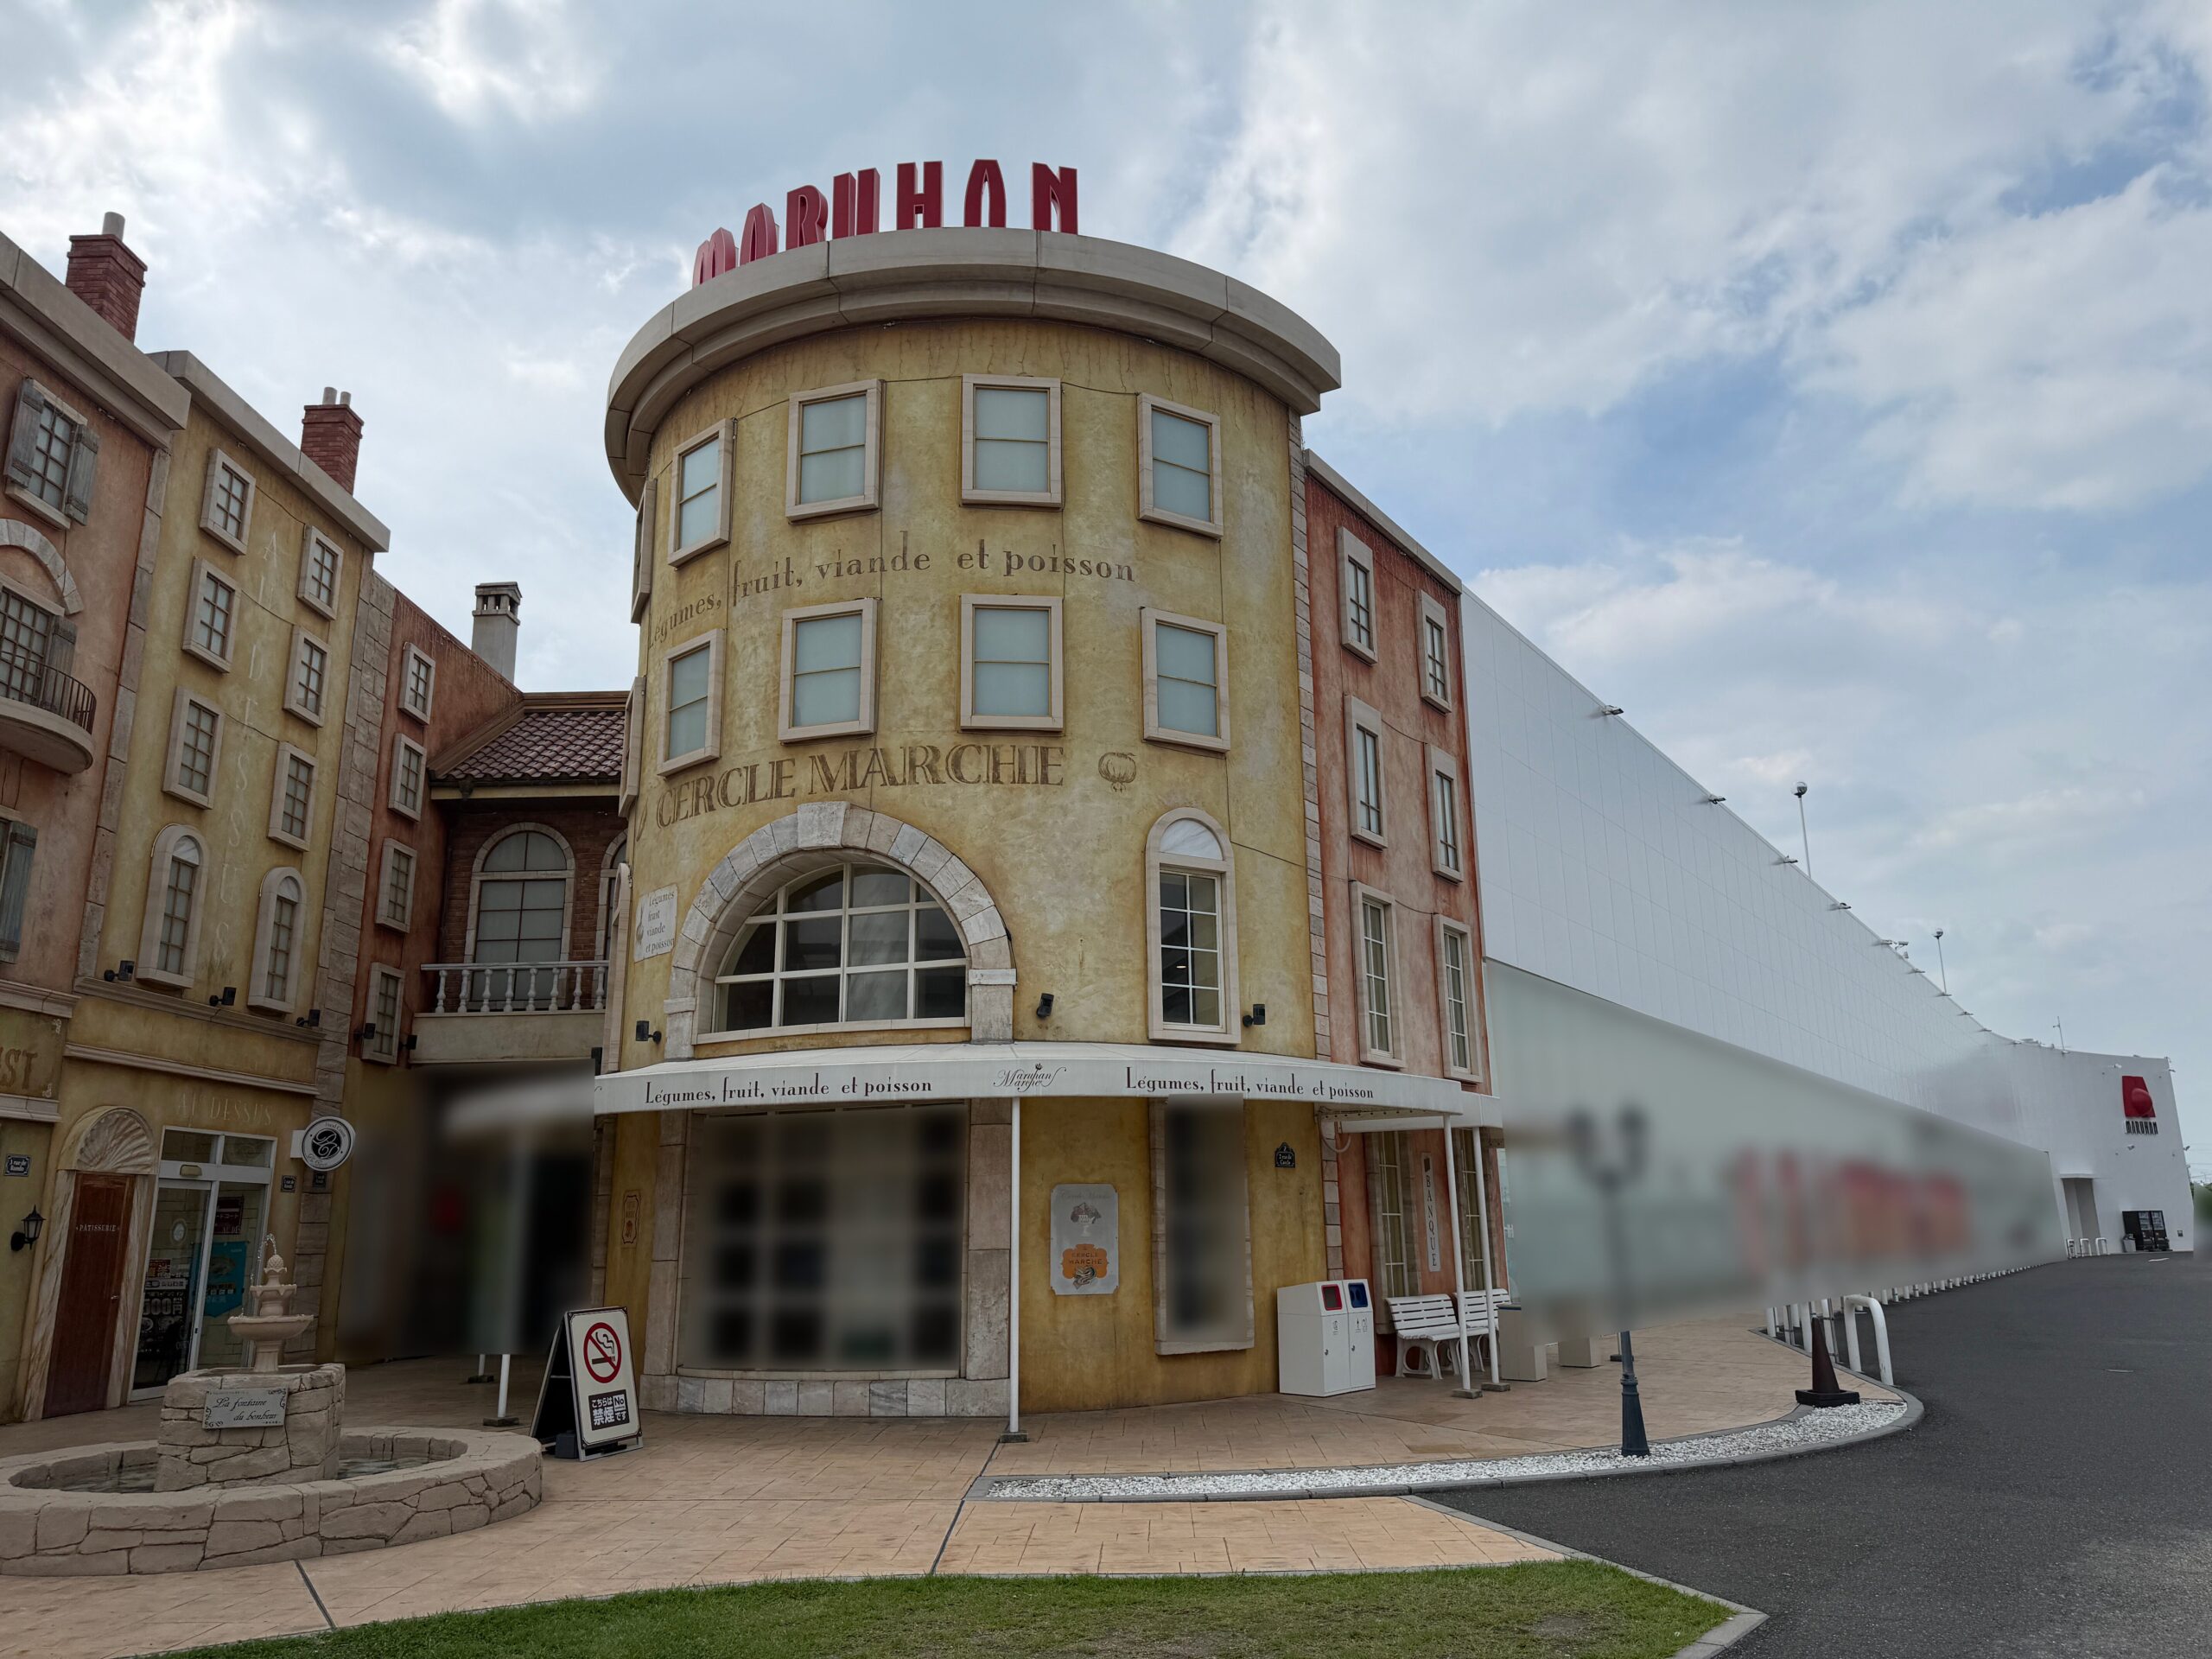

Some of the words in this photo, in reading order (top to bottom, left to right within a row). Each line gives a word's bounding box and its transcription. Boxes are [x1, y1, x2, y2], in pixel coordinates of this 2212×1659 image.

[692, 159, 1077, 288] MARUHAN
[733, 556, 803, 607] fruit,
[816, 531, 931, 580] viande
[957, 538, 989, 569] et
[1003, 543, 1135, 582] poisson
[657, 758, 796, 829] CERCLE
[809, 744, 1065, 795] MARCHE
[645, 1081, 715, 1105] Légumes,
[722, 1077, 765, 1102] fruit,
[772, 1072, 830, 1097] viande
[842, 1077, 857, 1094] et
[864, 1077, 932, 1096] poisson
[1126, 1066, 1205, 1092] Légumes,
[1211, 1069, 1250, 1093] fruit,
[1255, 1073, 1304, 1095] viande
[1313, 1080, 1325, 1096] et
[1329, 1082, 1374, 1099] poisson
[2126, 1121, 2158, 1135] MARUHAN
[1426, 1174, 1438, 1267] BANQUE
[212, 1396, 231, 1408] La
[230, 1397, 268, 1412] fontaine
[233, 1411, 245, 1421] du
[245, 1409, 276, 1421] bonheur
[592, 1396, 613, 1408] こちらは
[614, 1396, 625, 1406] No
